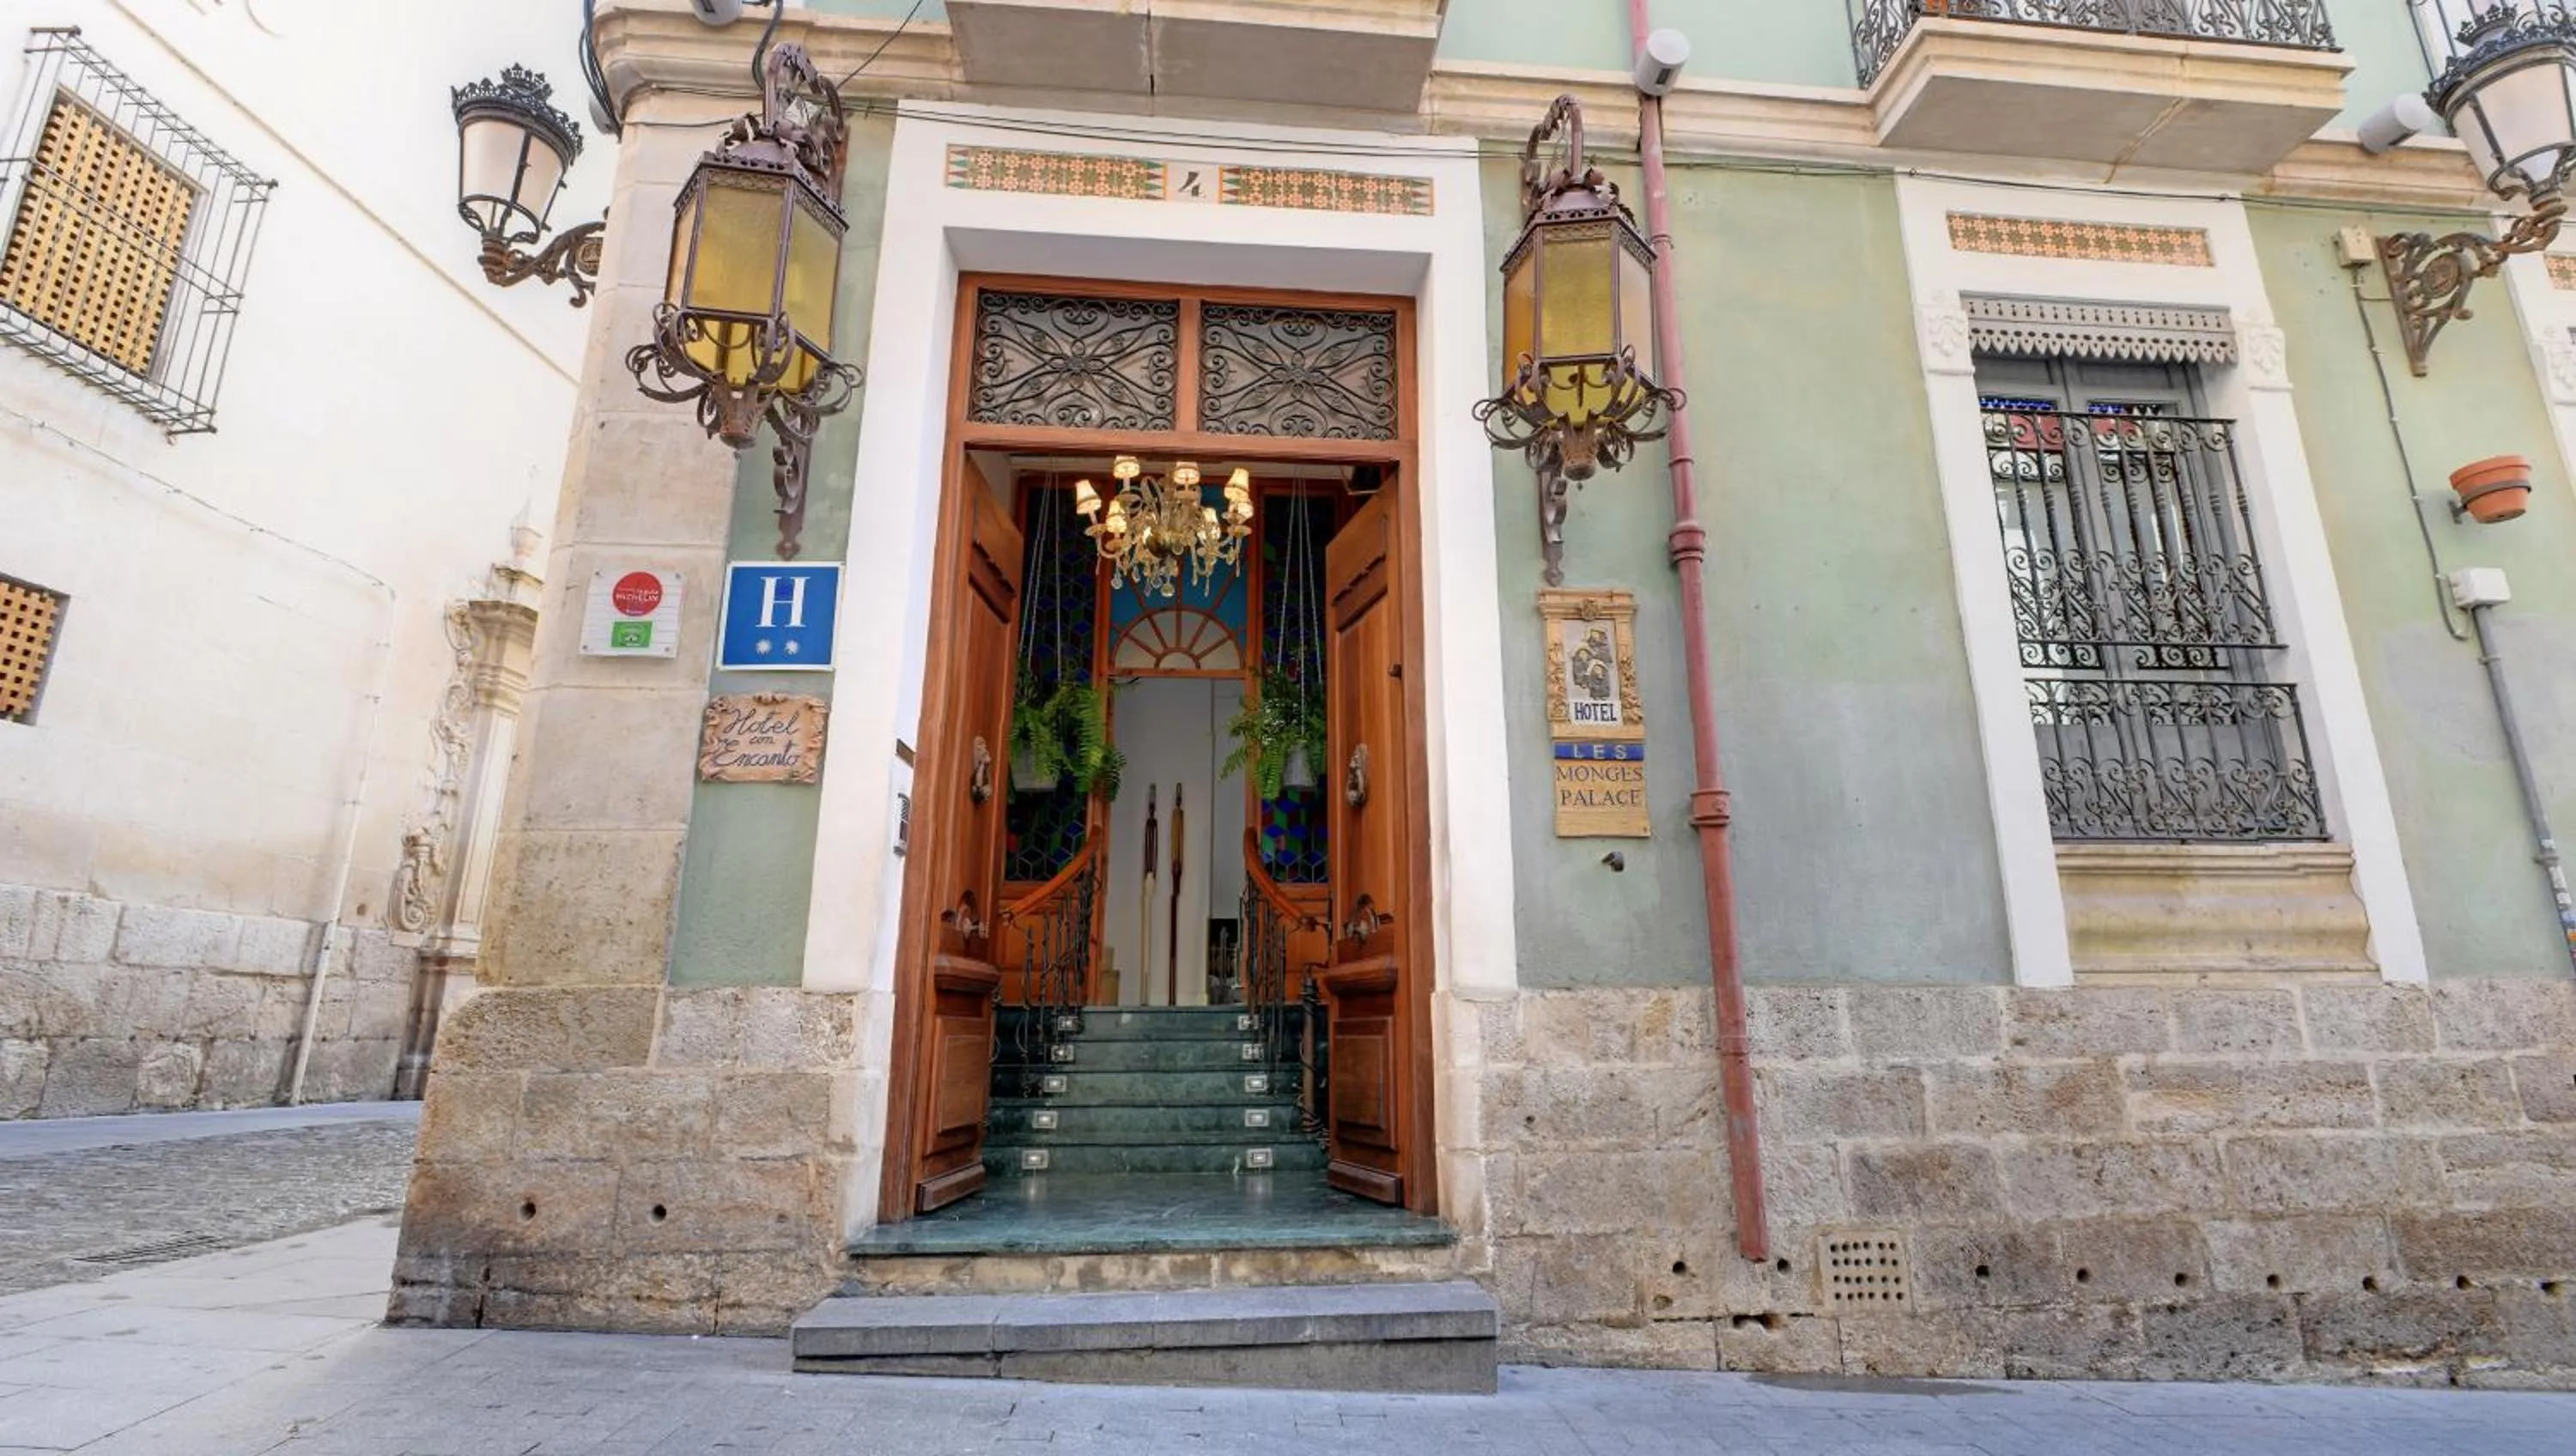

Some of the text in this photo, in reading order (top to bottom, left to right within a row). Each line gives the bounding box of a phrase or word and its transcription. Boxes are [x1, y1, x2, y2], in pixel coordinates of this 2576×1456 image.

[755, 576, 811, 628] H
[723, 707, 801, 736] Hotel
[1574, 702, 1617, 722] HOTEL
[749, 736, 775, 744] con
[712, 737, 801, 767] Encanto
[1573, 744, 1628, 760] LES
[1556, 765, 1643, 782] MONGES
[1560, 789, 1643, 807] PALACE
